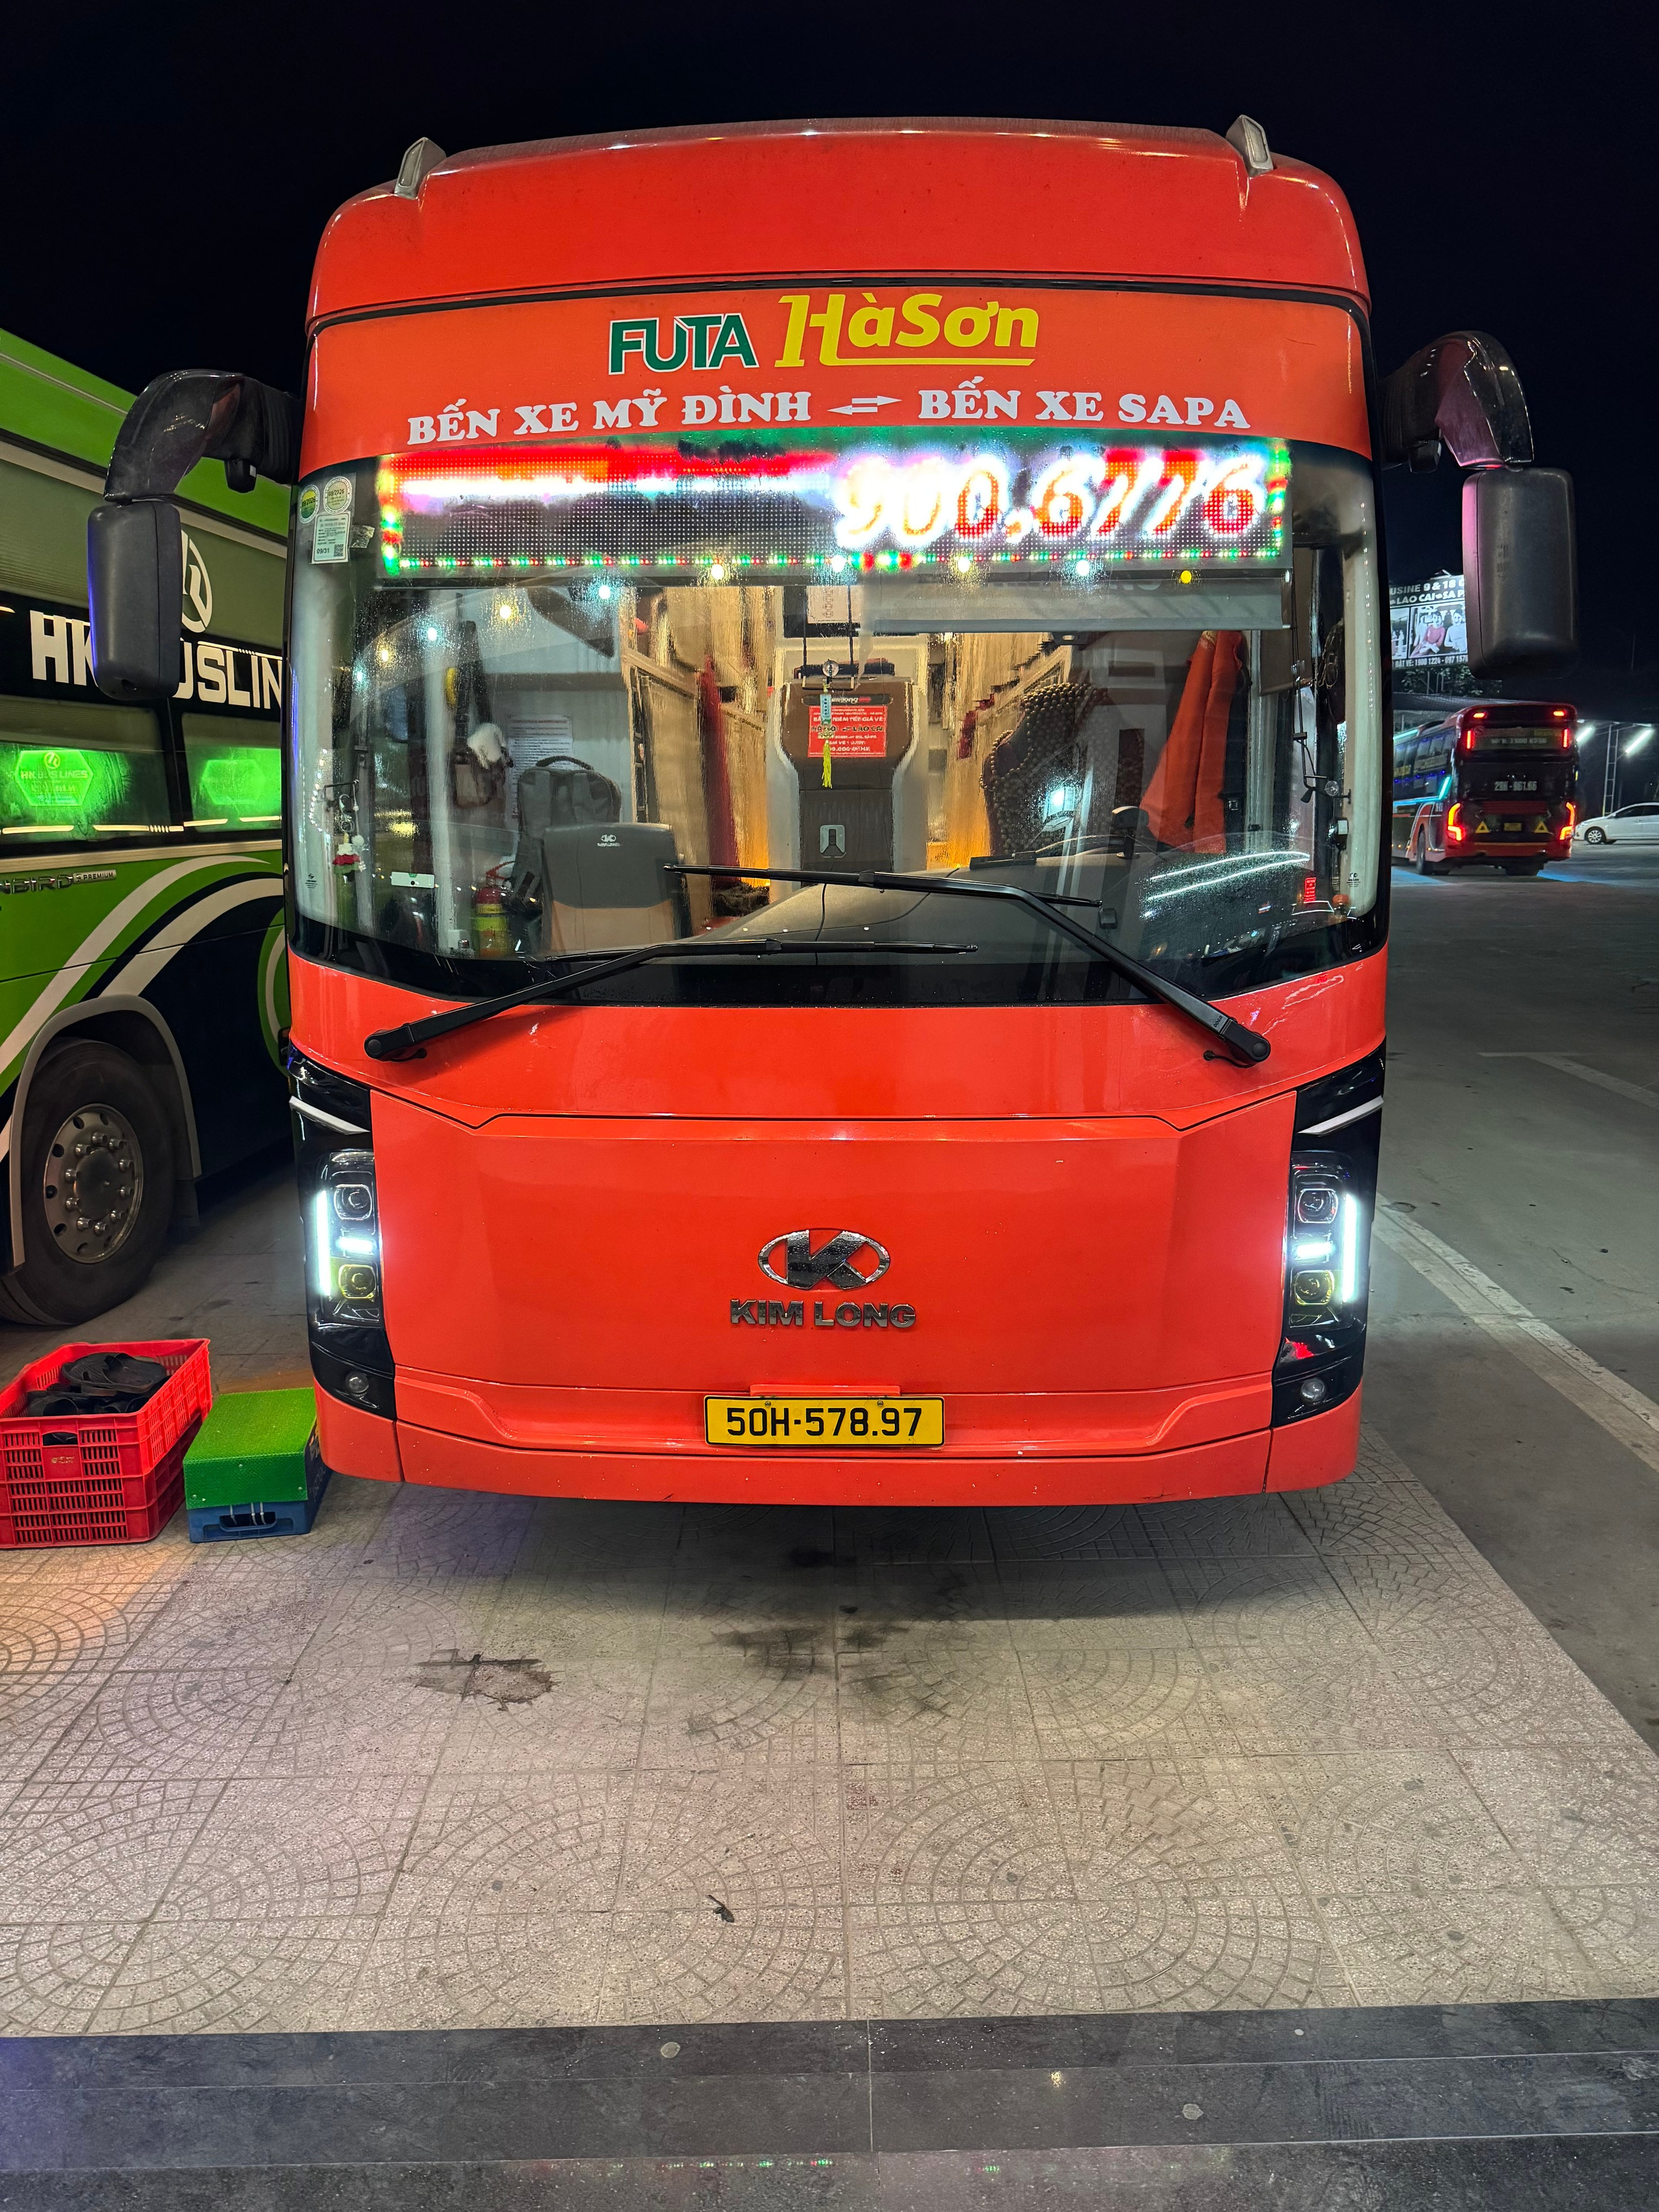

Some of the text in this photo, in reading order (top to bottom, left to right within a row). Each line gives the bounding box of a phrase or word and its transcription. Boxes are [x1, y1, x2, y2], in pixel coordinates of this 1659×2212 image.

[608, 312, 760, 375] FUTA
[408, 375, 1251, 445] BẾN XE MỸ ĐÌNH BẾN XE SAPA
[1397, 595, 1417, 605] LAO
[1419, 592, 1435, 602] CAI
[1443, 590, 1456, 600] SA
[1423, 583, 1430, 591] 9
[1432, 582, 1441, 590] &
[1443, 579, 1456, 589] 18
[84, 872, 113, 880] PREMIUM
[730, 1298, 916, 1329] KIM LONG
[727, 1407, 922, 1437] 50H-578.97
